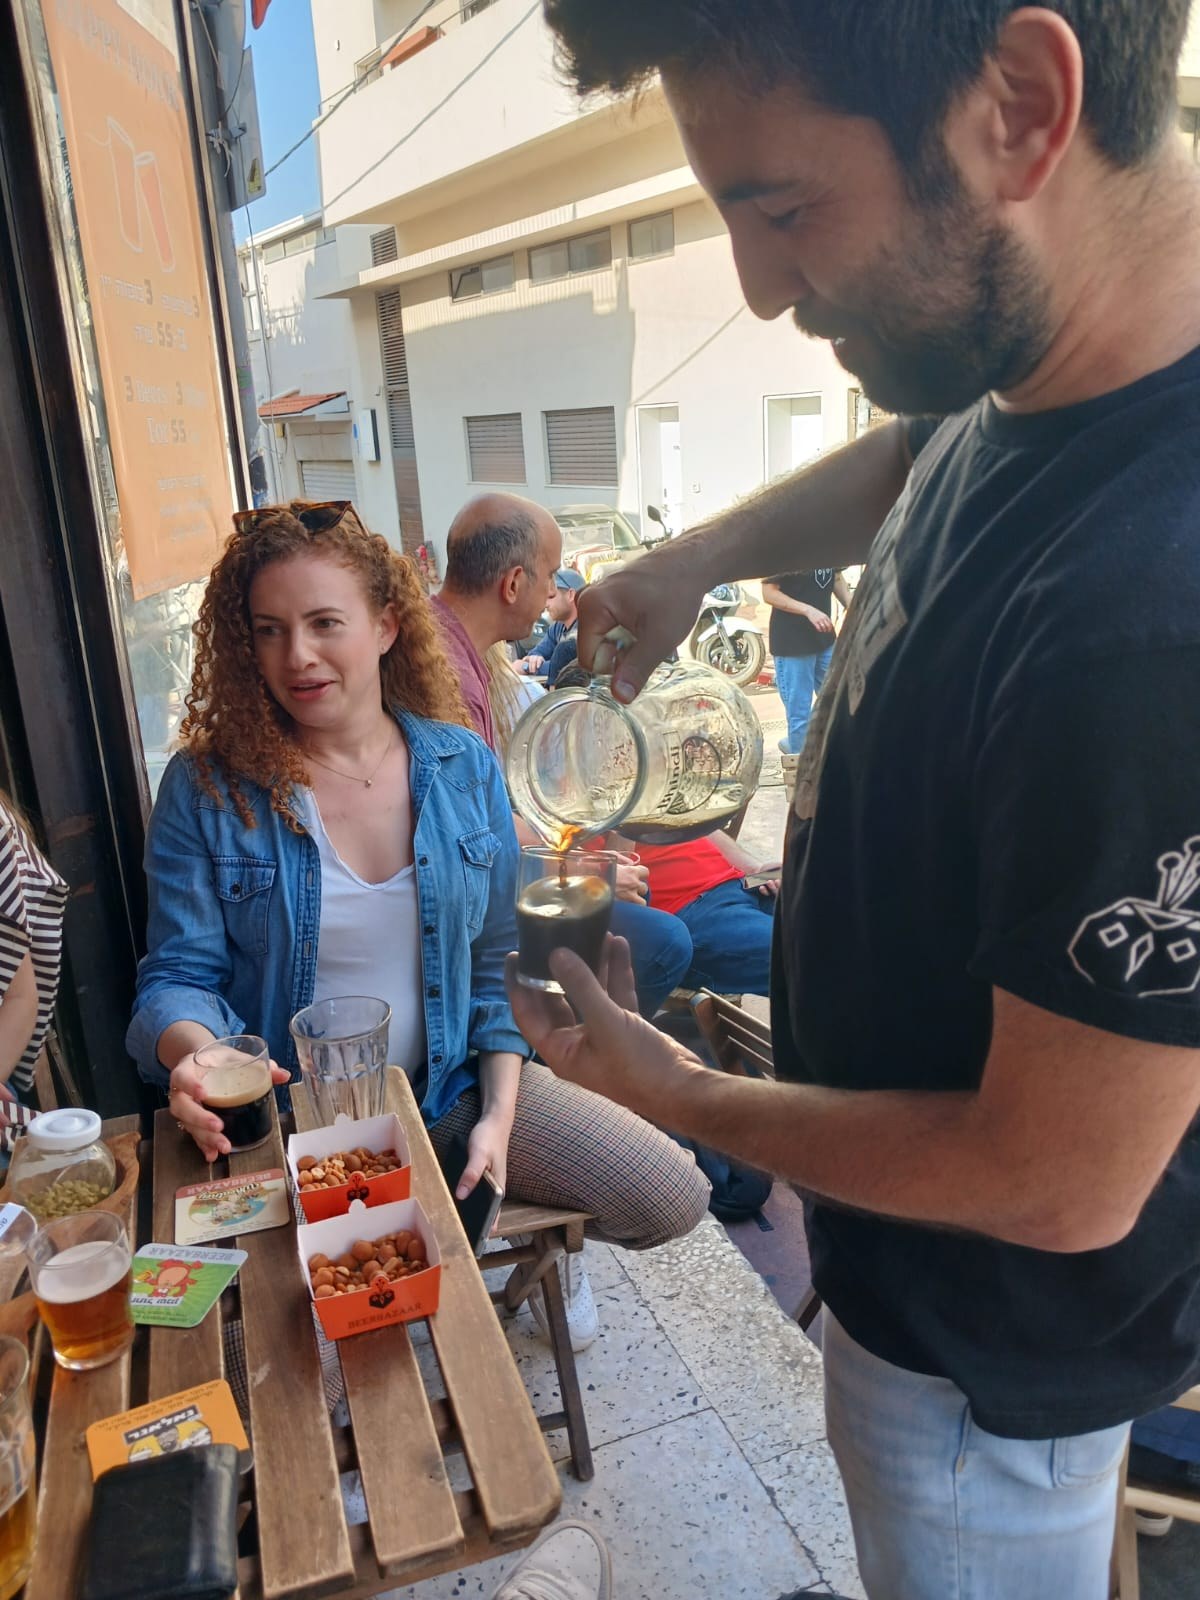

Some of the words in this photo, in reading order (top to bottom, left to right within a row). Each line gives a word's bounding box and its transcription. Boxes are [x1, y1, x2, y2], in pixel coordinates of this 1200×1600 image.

[187, 1172, 273, 1197] BEERBAZAAR
[151, 1246, 235, 1261] BEERBAZAAR
[347, 1302, 423, 1329] BEERBAZAAR
